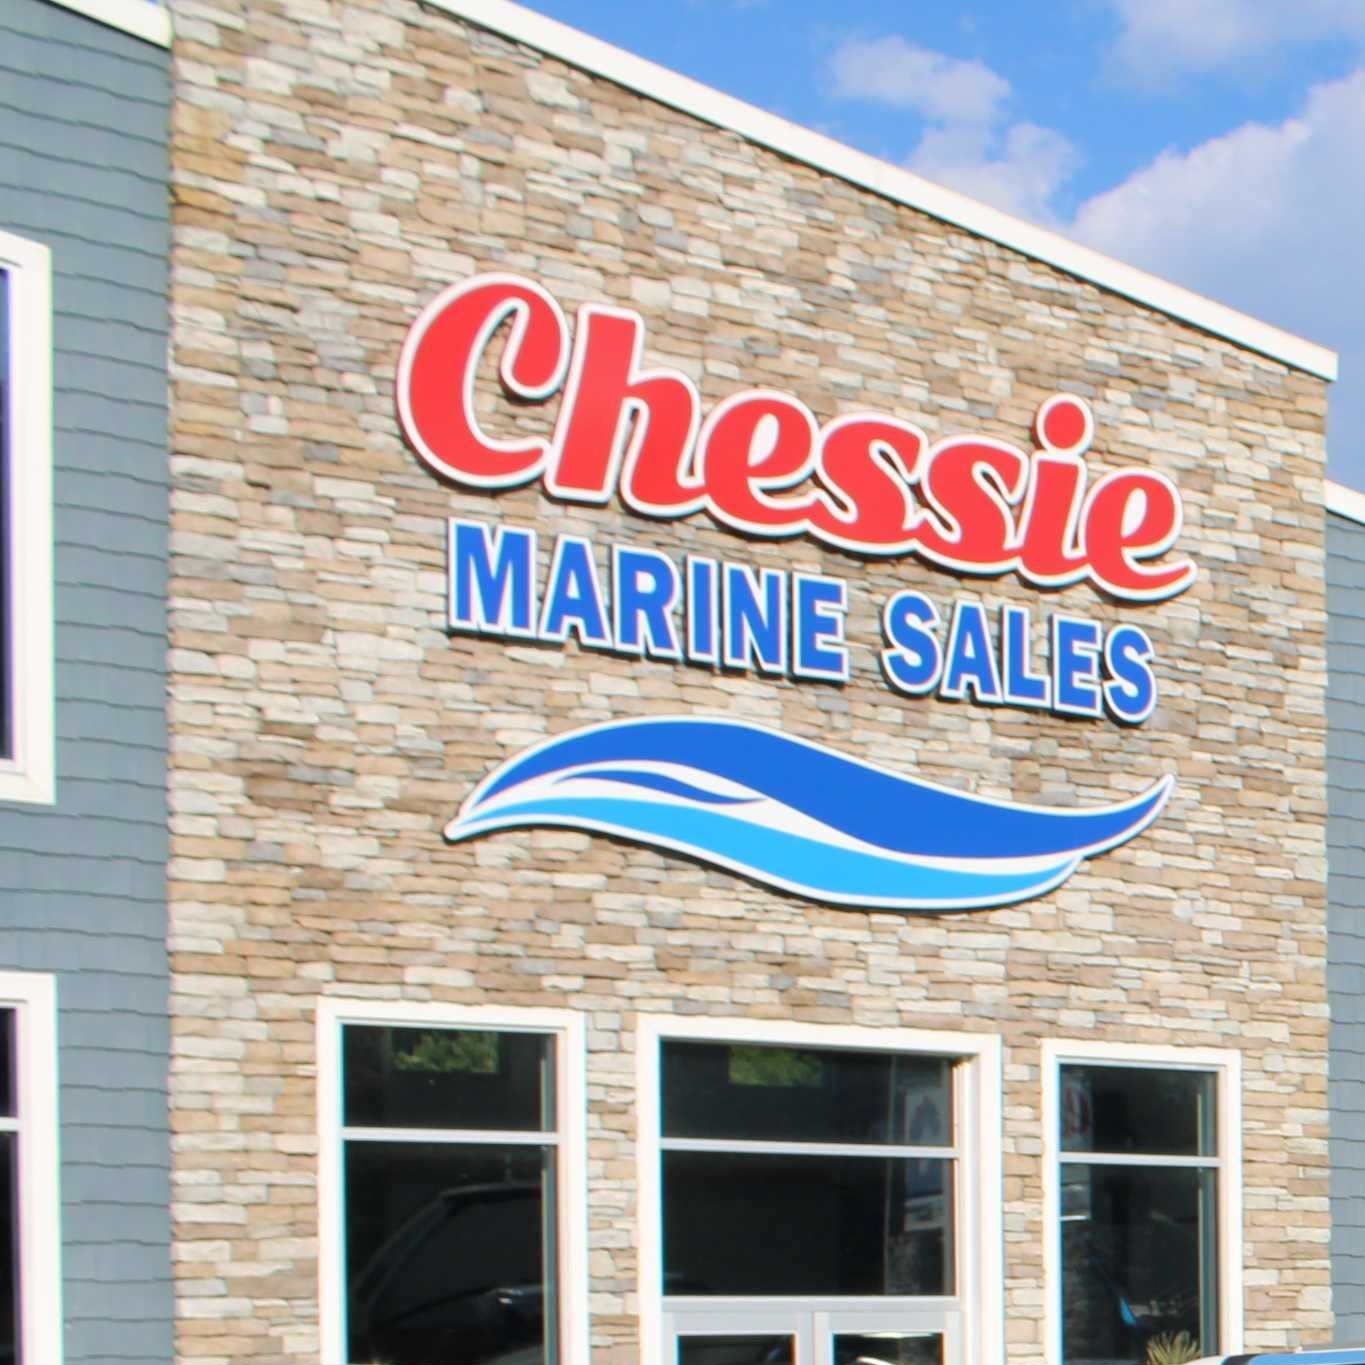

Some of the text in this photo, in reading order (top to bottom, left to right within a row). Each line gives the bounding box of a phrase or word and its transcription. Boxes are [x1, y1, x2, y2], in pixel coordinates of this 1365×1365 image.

[398, 273, 1196, 599] Chessie
[447, 517, 1157, 724] MARINE SALES
